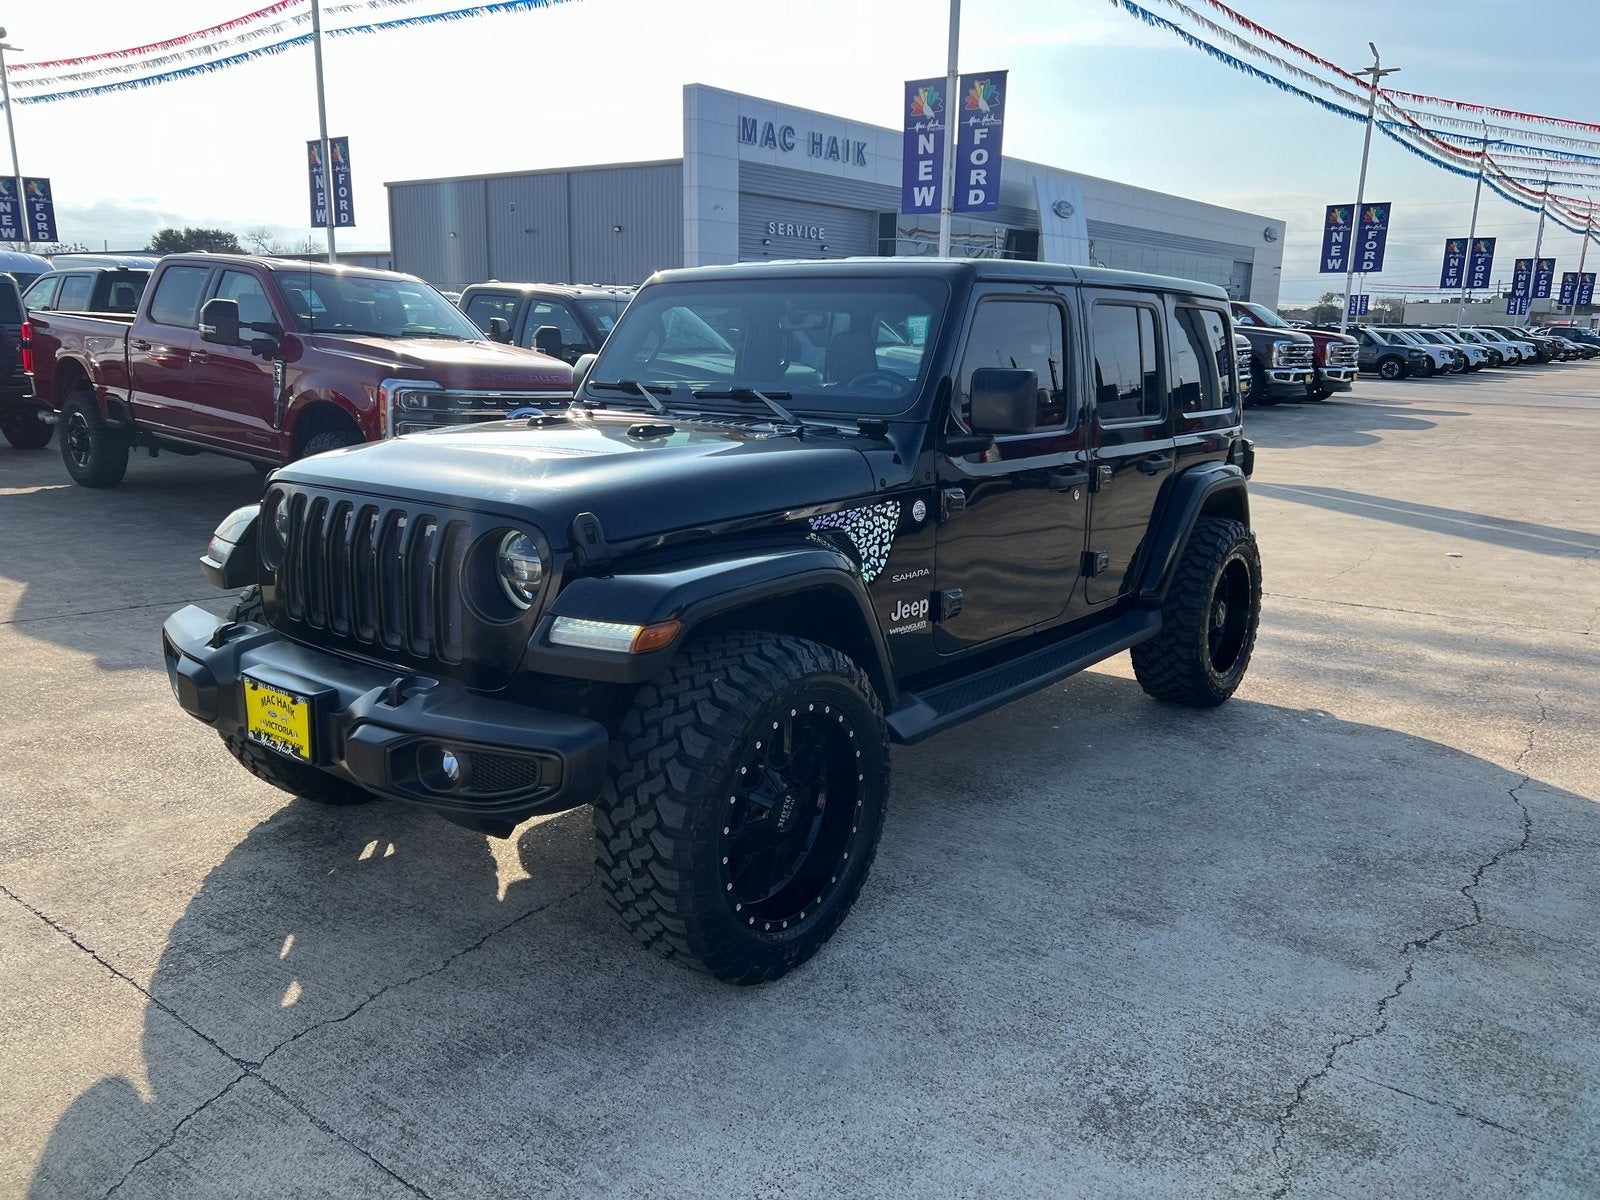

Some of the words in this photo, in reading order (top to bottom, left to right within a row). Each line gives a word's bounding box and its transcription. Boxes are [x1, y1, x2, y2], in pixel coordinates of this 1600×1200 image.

[739, 115, 795, 152] MAC
[808, 131, 867, 167] HAIK
[913, 133, 935, 207] NEW
[967, 128, 989, 206] FORD
[315, 174, 327, 223] NEW
[338, 174, 349, 224] FORD
[0, 202, 16, 239] NEW
[35, 203, 50, 240] FORD
[768, 221, 825, 239] SERVICE
[1326, 231, 1344, 270] NEW
[1362, 230, 1378, 270] FORD
[1445, 258, 1459, 286] NEW
[1473, 257, 1486, 287] FORD
[1515, 273, 1526, 297] NEW
[1537, 274, 1548, 297] FORD
[1562, 285, 1572, 304] NEW
[891, 568, 930, 583] SAHARA
[890, 598, 929, 622] Jeep
[889, 620, 927, 635] WRANGLER
[261, 695, 276, 708] MAC
[277, 697, 295, 720] HAIK
[264, 718, 293, 736] VICTORIA
